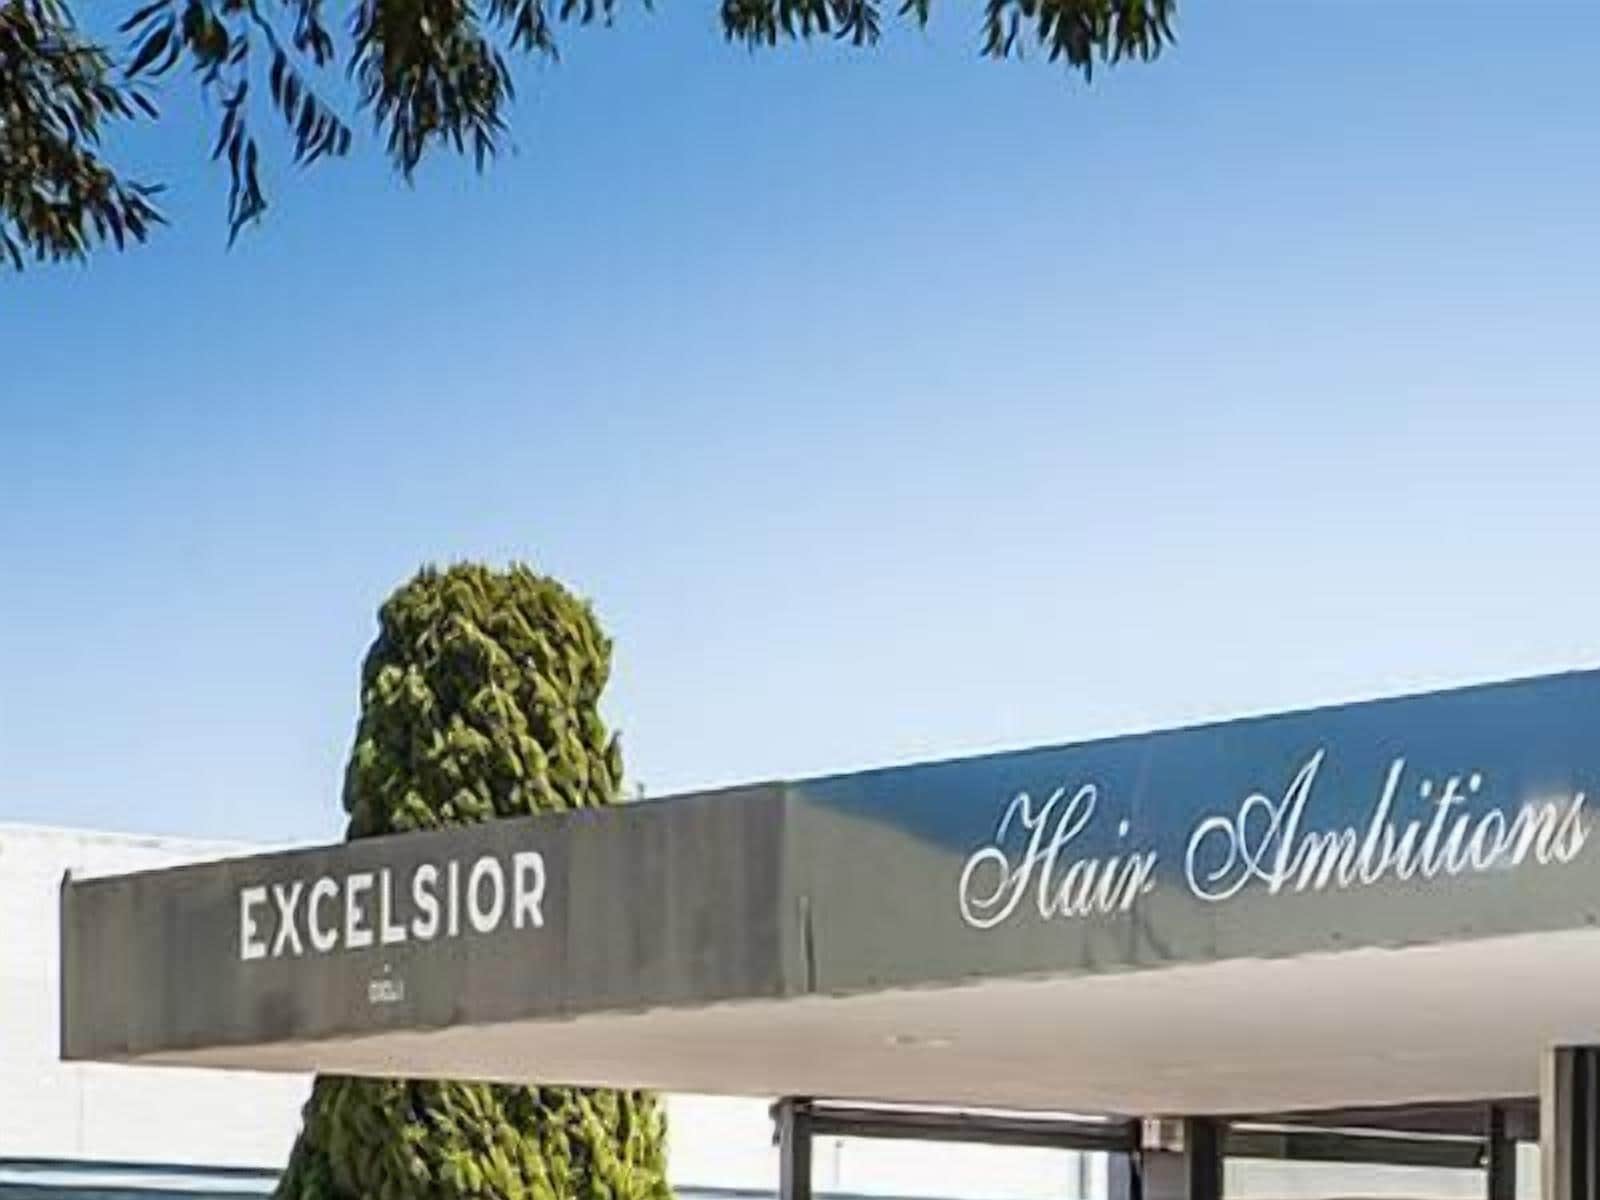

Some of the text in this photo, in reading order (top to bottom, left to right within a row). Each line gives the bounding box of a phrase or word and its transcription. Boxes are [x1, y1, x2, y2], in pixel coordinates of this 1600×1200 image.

[240, 851, 547, 960] EXCELSIOR
[959, 749, 1592, 928] Hair Ambitions
